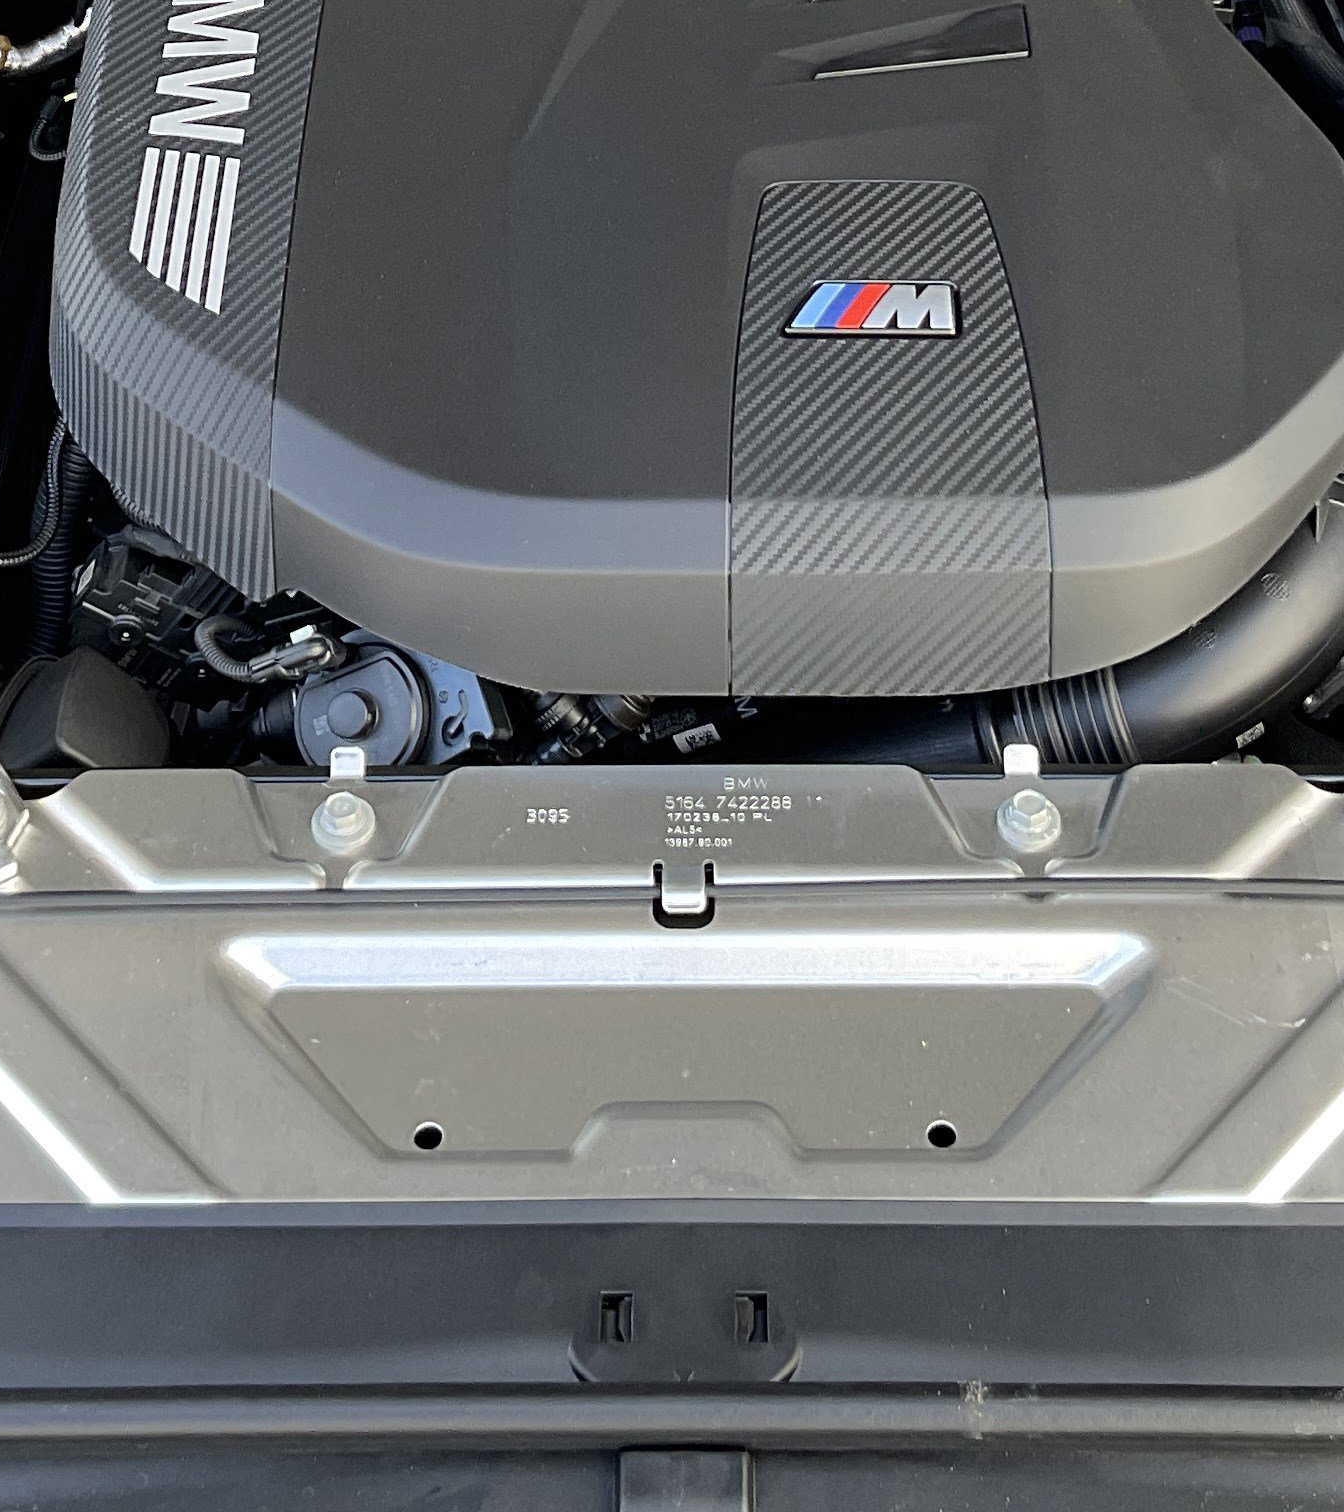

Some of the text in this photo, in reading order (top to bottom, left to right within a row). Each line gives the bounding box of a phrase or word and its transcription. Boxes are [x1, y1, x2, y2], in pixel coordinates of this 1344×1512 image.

[723, 776, 768, 790] BMW
[664, 795, 705, 809] 5164
[716, 795, 792, 809] 7422288
[526, 808, 570, 823] 3095
